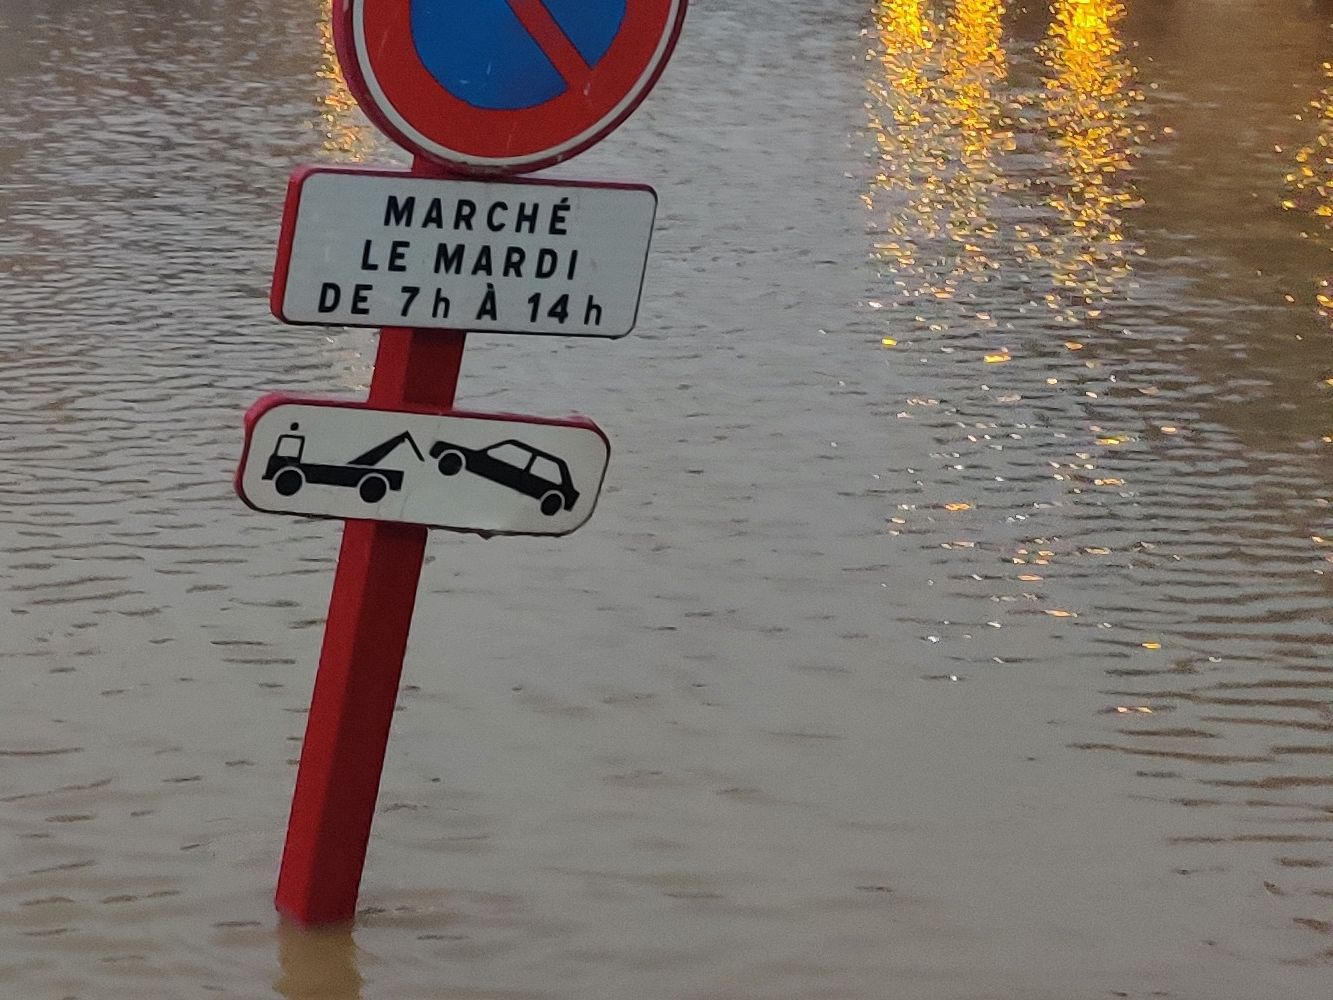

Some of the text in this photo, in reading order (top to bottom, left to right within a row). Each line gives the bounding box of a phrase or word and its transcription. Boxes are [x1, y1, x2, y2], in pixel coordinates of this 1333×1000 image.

[383, 194, 572, 236] MARCHÉ
[360, 238, 579, 281] LE MARDI
[317, 281, 374, 316] DE
[400, 285, 451, 319] 7h
[474, 282, 499, 322] À
